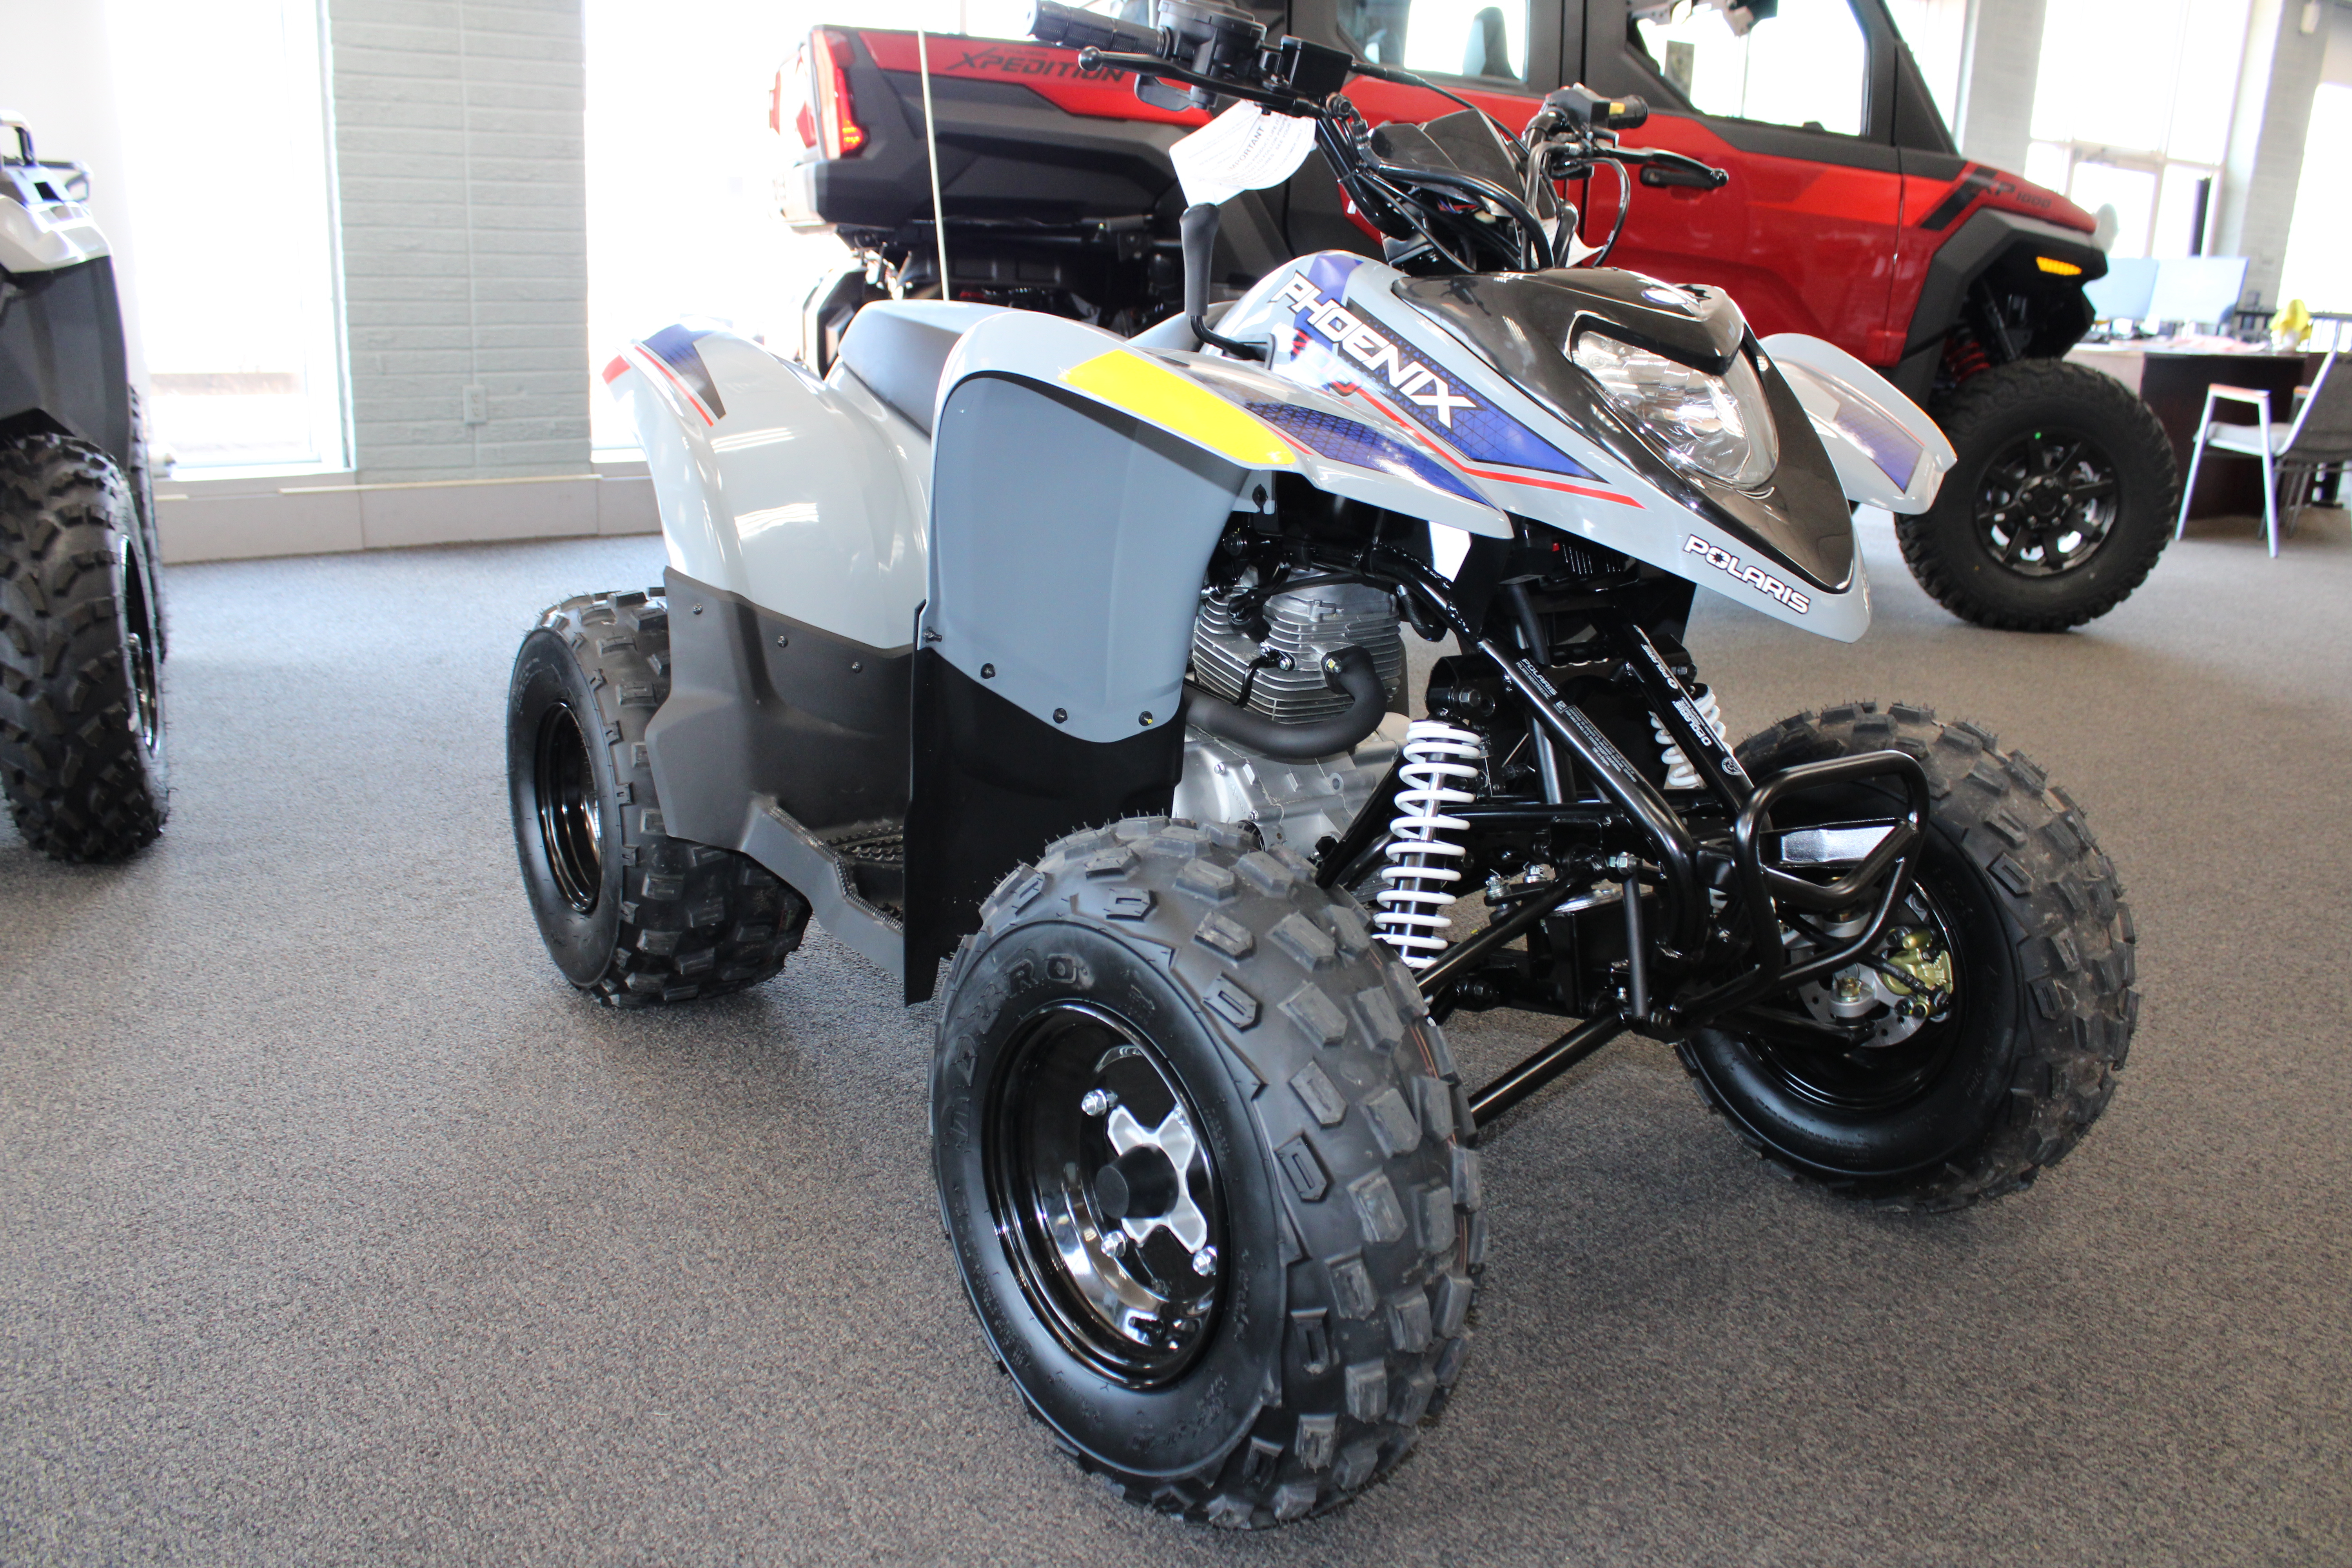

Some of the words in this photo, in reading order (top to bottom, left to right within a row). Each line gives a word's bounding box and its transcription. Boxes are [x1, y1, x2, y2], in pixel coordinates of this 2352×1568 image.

[945, 46, 1125, 83] XPEDITION
[1226, 125, 1264, 170] IMPORTANT
[1252, 138, 1270, 162] PRODUCT
[1269, 125, 1277, 137] LIFE
[2016, 192, 2053, 209] 1000
[1269, 271, 1478, 429] PHOENIX
[1683, 534, 1811, 614] POLARIS
[1515, 662, 1529, 676] POLARIS
[1527, 674, 1545, 694] INDUSTRIES
[1521, 658, 1558, 696] POLARIS
[1641, 645, 1671, 679] POLARIS
[1570, 715, 1578, 724] SALE
[1588, 735, 1599, 747] STATES
[1596, 745, 1608, 757] EXCEPT
[1584, 724, 1596, 737] OPERATE
[1673, 701, 1705, 739] POLARIS
